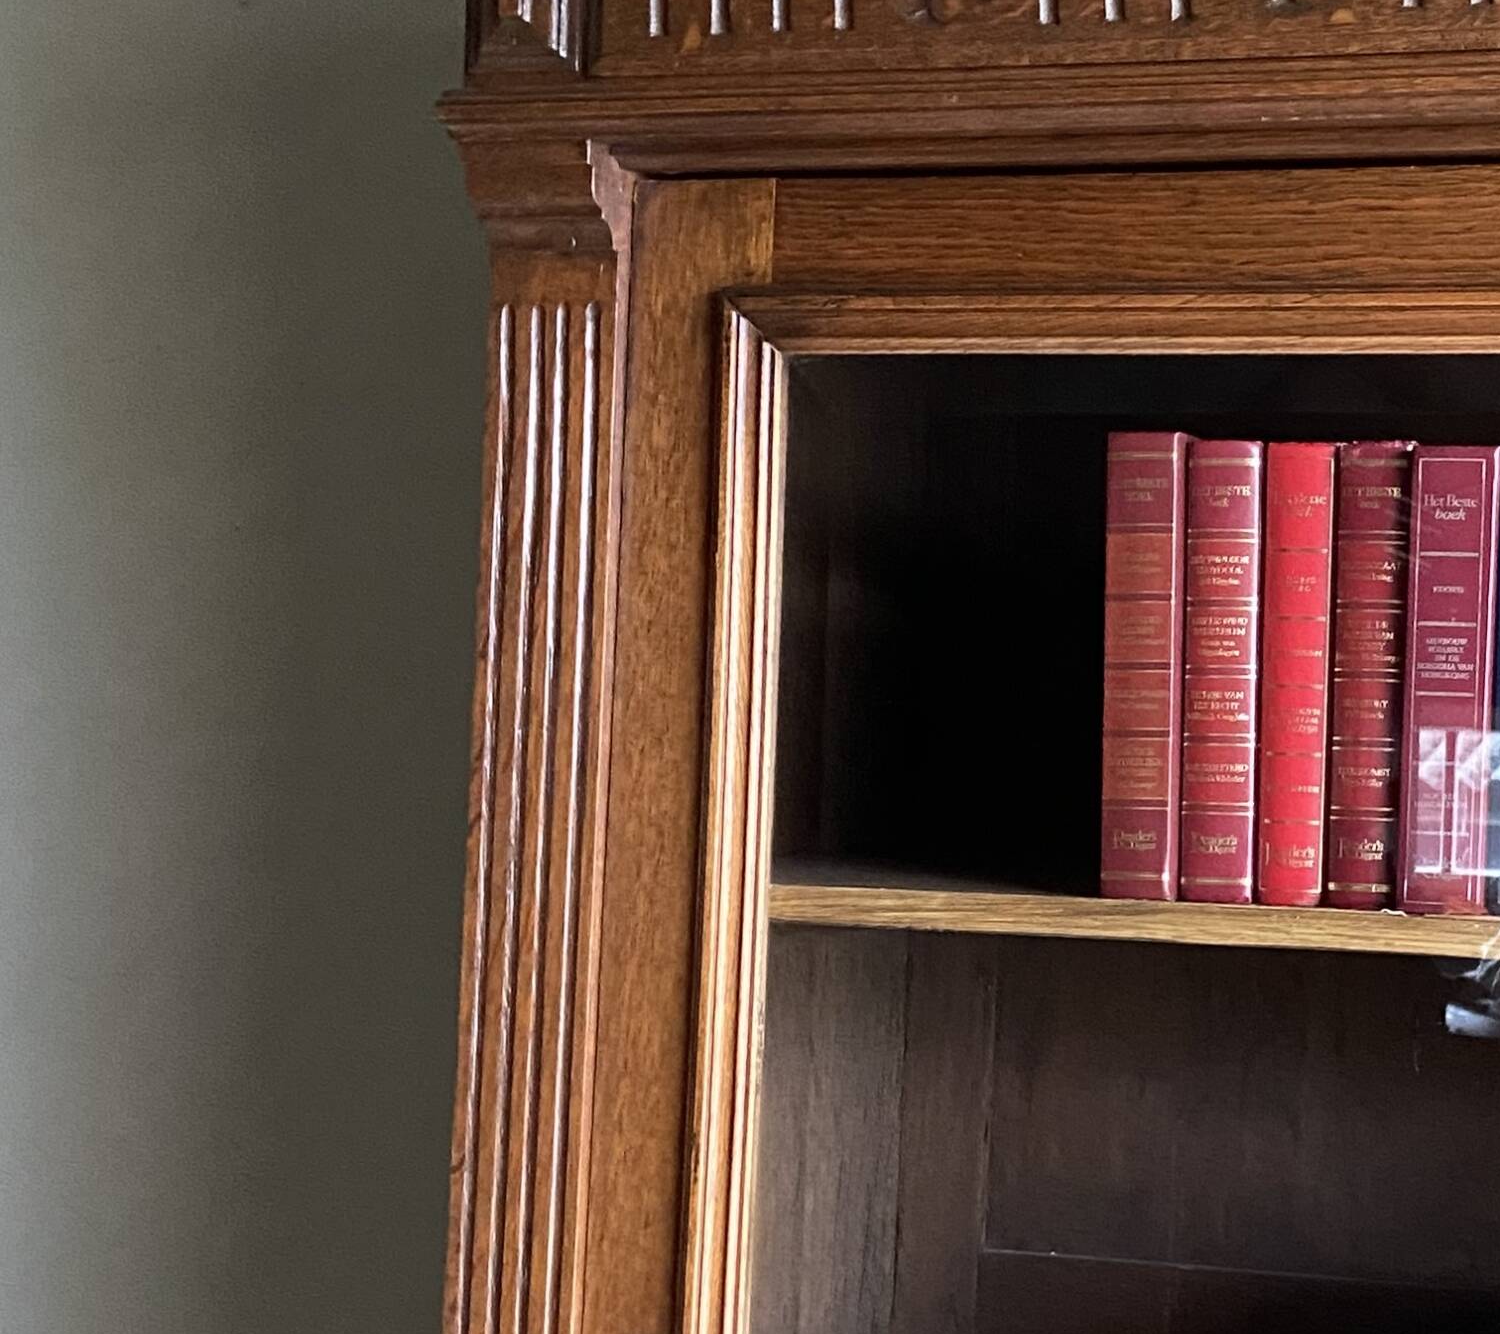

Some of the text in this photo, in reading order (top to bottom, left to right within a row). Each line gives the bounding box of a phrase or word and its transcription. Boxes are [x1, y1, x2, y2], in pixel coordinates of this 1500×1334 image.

[1424, 493, 1480, 508] Het Beste
[1434, 508, 1466, 521] boek
